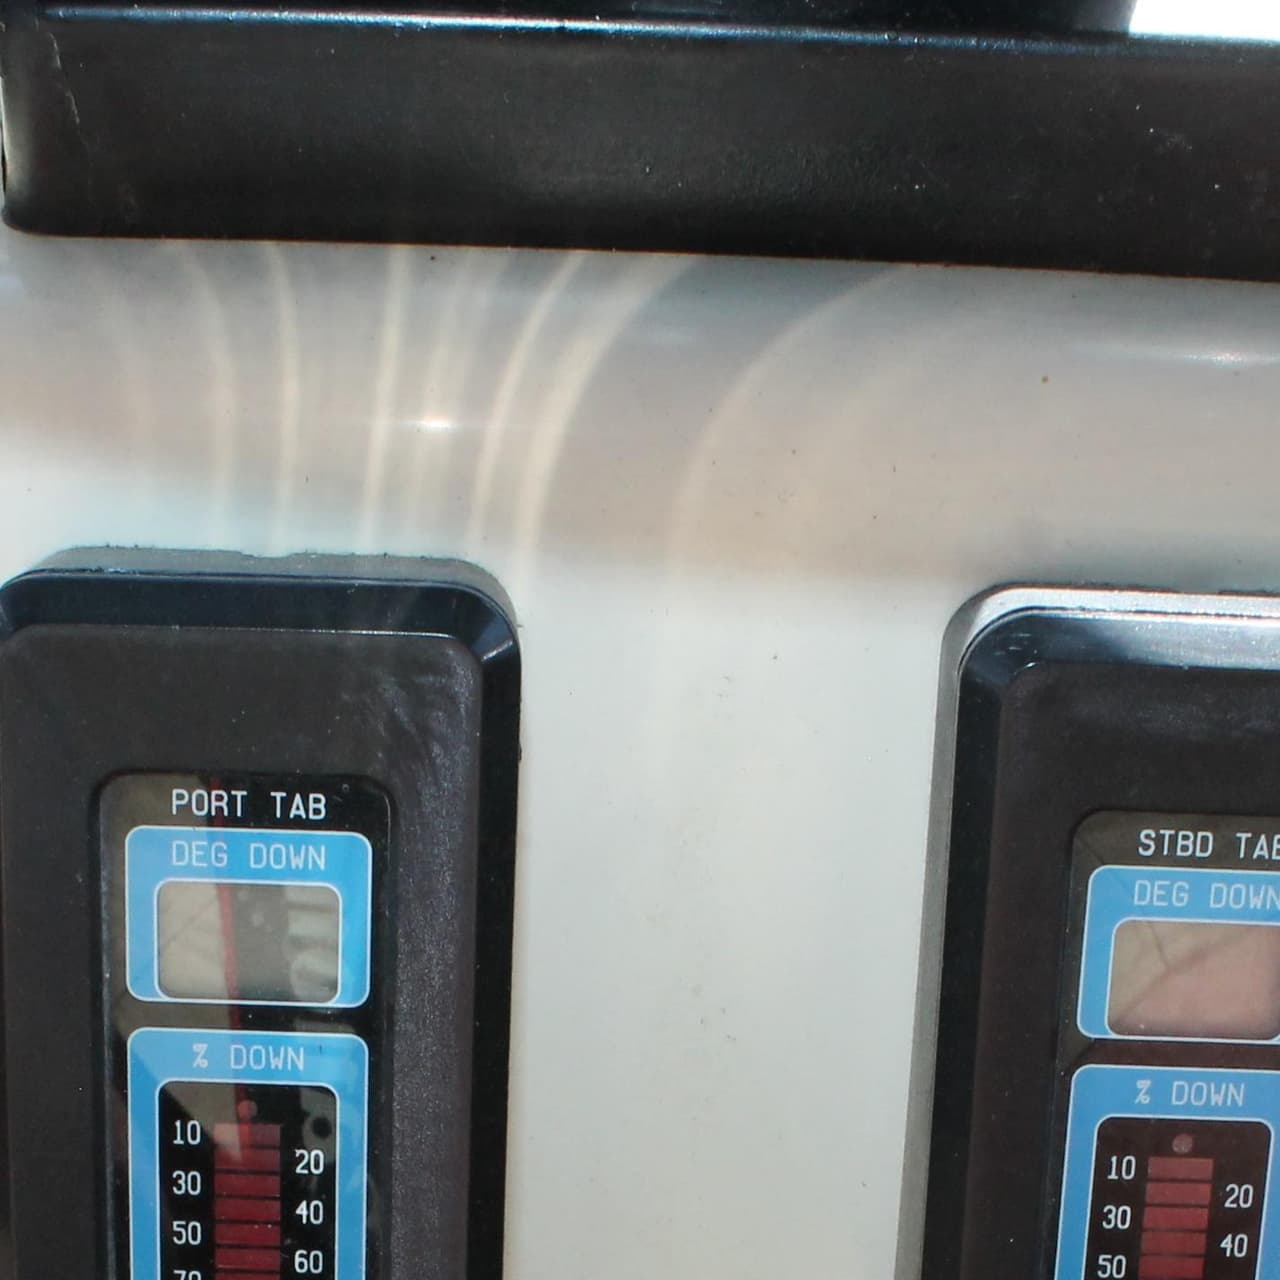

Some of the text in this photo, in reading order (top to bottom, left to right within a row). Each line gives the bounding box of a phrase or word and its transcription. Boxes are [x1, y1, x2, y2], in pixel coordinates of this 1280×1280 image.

[171, 788, 327, 820] PORT TAB
[172, 840, 326, 870] DEG DOWN
[1138, 829, 1214, 858] STBD
[1133, 879, 1189, 906] DEG
[192, 1043, 305, 1071] % DOWN
[1135, 1079, 1245, 1107] % DOWN
[173, 1121, 201, 1145] 10
[294, 1149, 325, 1175] 20
[1106, 1155, 1136, 1180] 10
[172, 1171, 202, 1195] 30
[1224, 1184, 1254, 1209] 20
[295, 1200, 324, 1225] 40
[1102, 1205, 1132, 1230] 30
[172, 1221, 202, 1245] 50
[1220, 1234, 1249, 1259] 40
[293, 1250, 324, 1274] 60
[1097, 1255, 1126, 1279] 50
